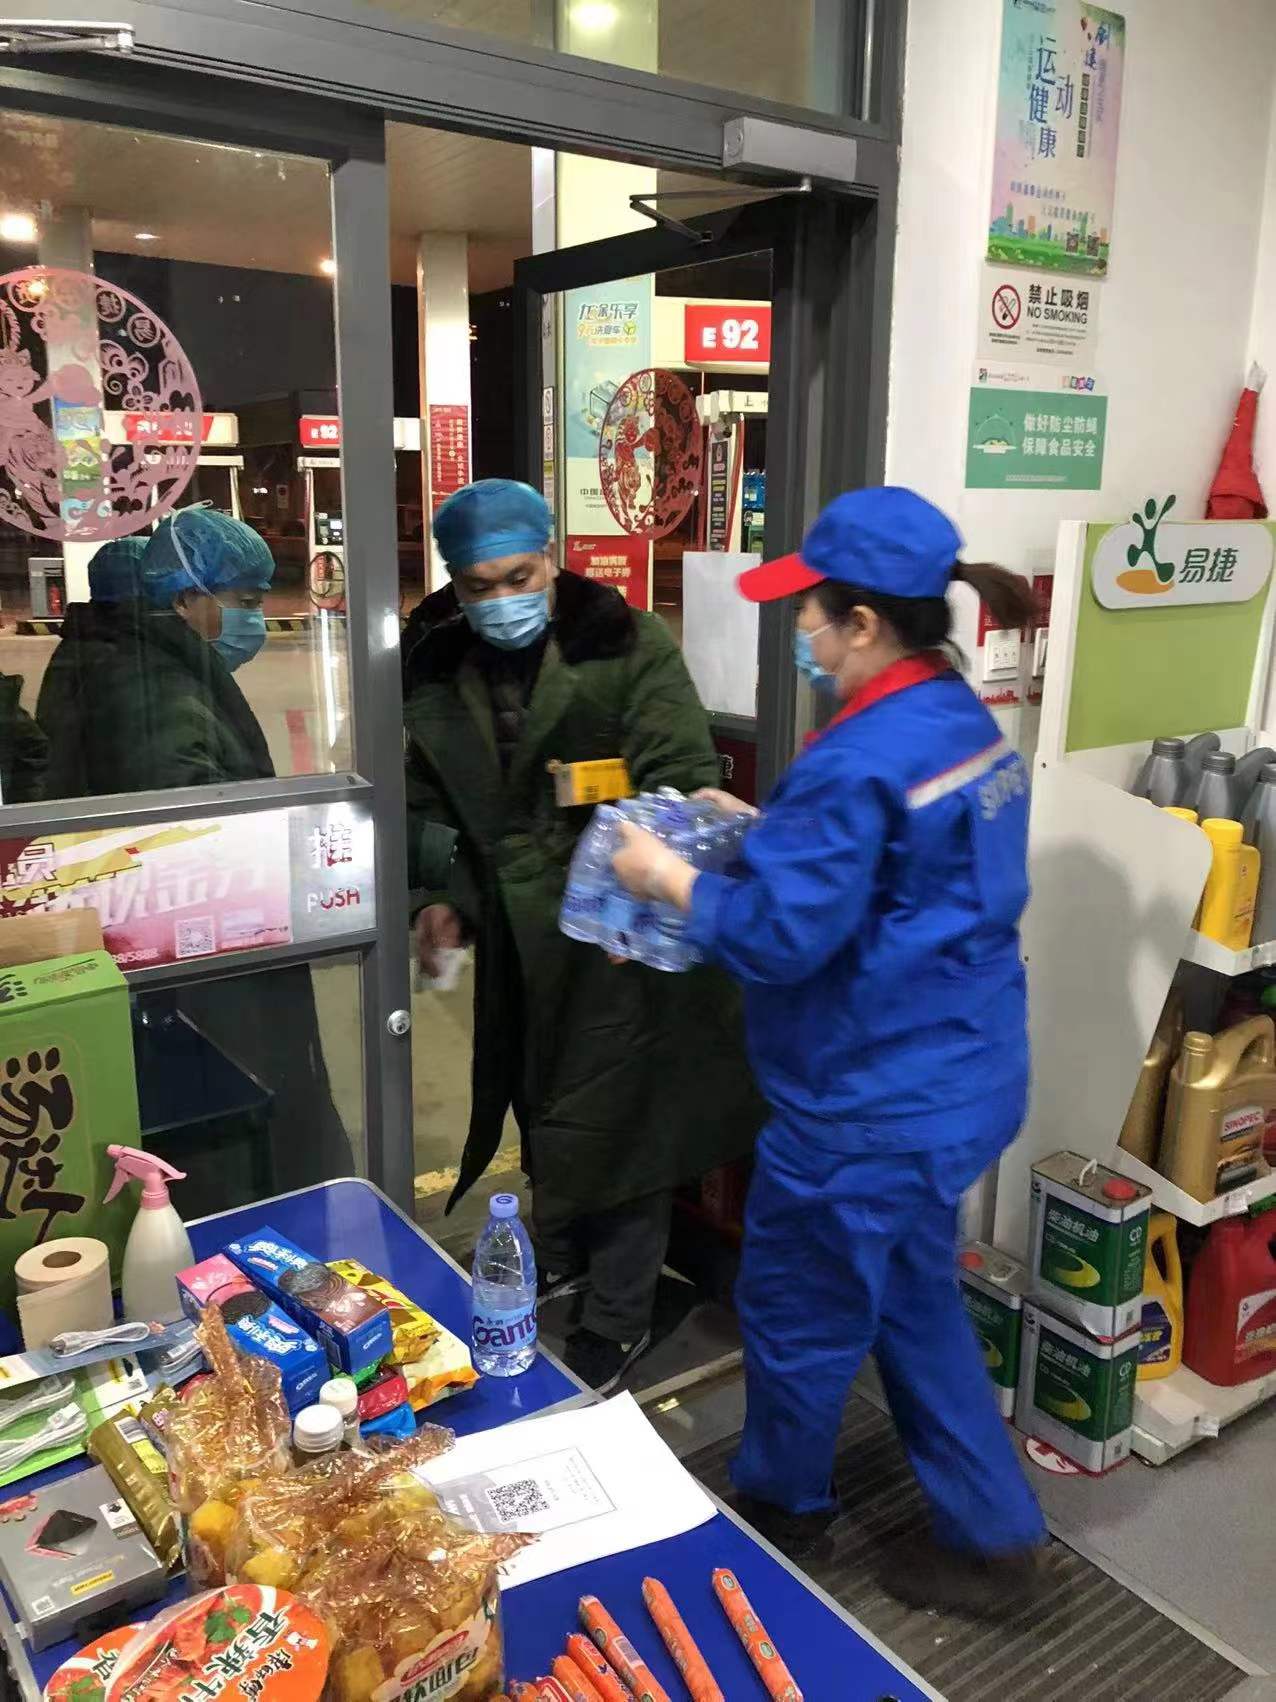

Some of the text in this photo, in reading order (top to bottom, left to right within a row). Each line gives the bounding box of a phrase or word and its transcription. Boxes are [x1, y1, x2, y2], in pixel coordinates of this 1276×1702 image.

[1028, 283, 1090, 311] 禁止吸烟
[1026, 305, 1088, 325] NO SMOKING
[702, 318, 759, 350] E 92
[1022, 435, 1097, 458] 保障食品安全
[1178, 547, 1240, 584] 易捷
[306, 887, 361, 913] PUSH
